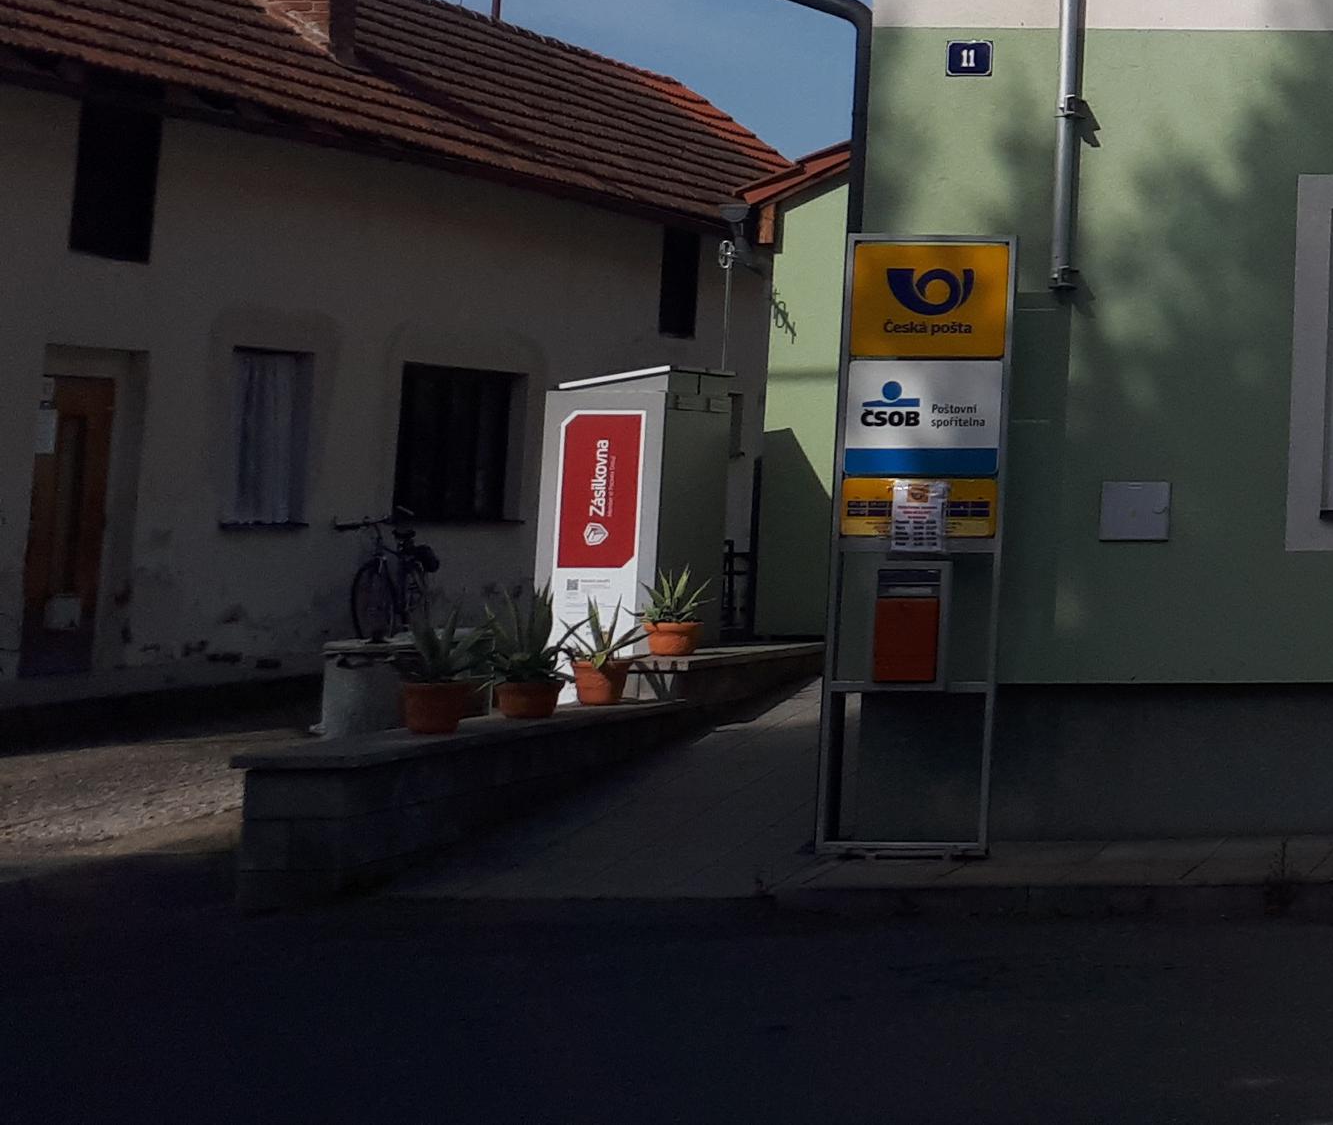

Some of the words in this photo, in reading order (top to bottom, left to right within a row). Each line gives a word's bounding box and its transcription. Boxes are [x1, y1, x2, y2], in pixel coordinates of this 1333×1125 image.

[960, 49, 976, 67] 11
[883, 318, 928, 333] Česká
[931, 321, 973, 335] pošta
[931, 403, 977, 414] Poštovní
[860, 408, 920, 427] ČSOB
[931, 416, 986, 429] spořitelna
[589, 439, 609, 517] Zásilkovna
